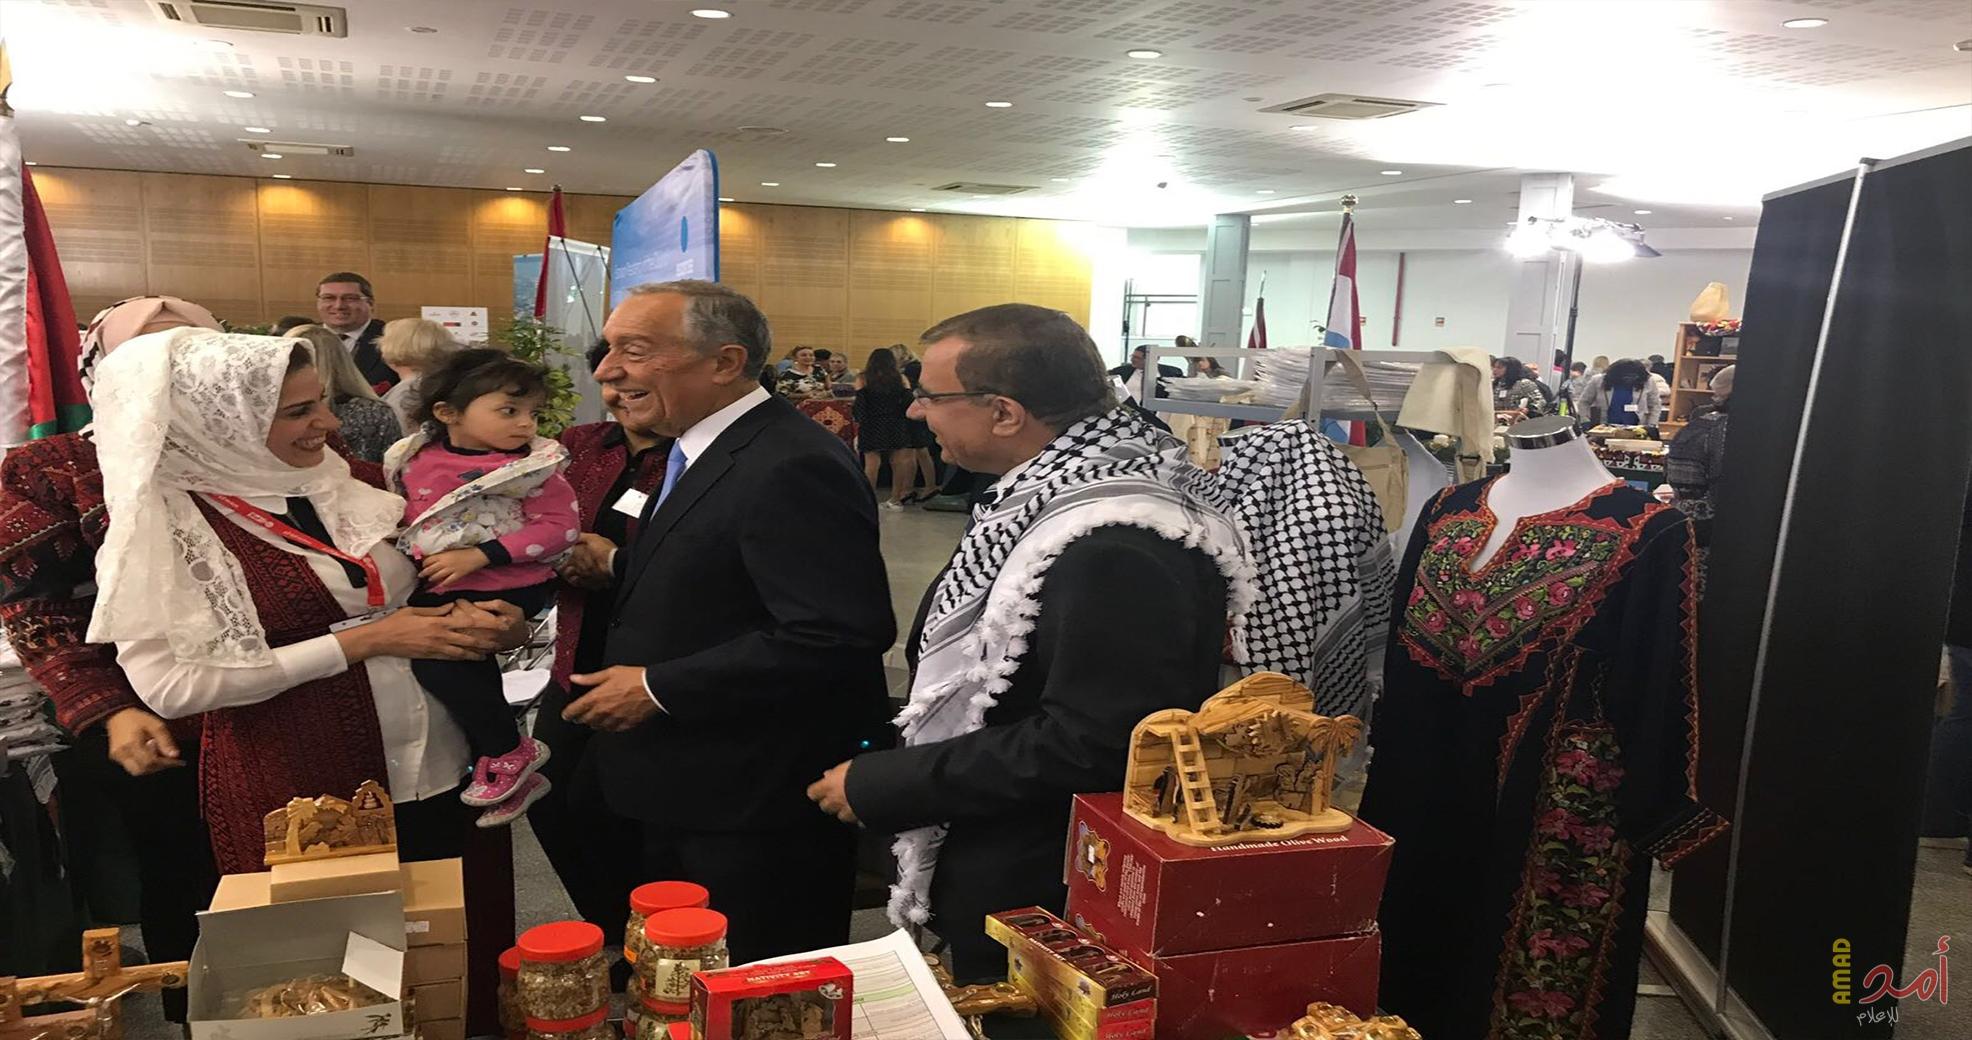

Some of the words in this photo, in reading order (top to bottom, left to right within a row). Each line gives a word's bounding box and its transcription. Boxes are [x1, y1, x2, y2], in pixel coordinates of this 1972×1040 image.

[1210, 840, 1279, 852] Handmade
[1280, 838, 1313, 847] Olive
[1313, 834, 1349, 844] Wood
[1111, 990, 1129, 1000] Holy
